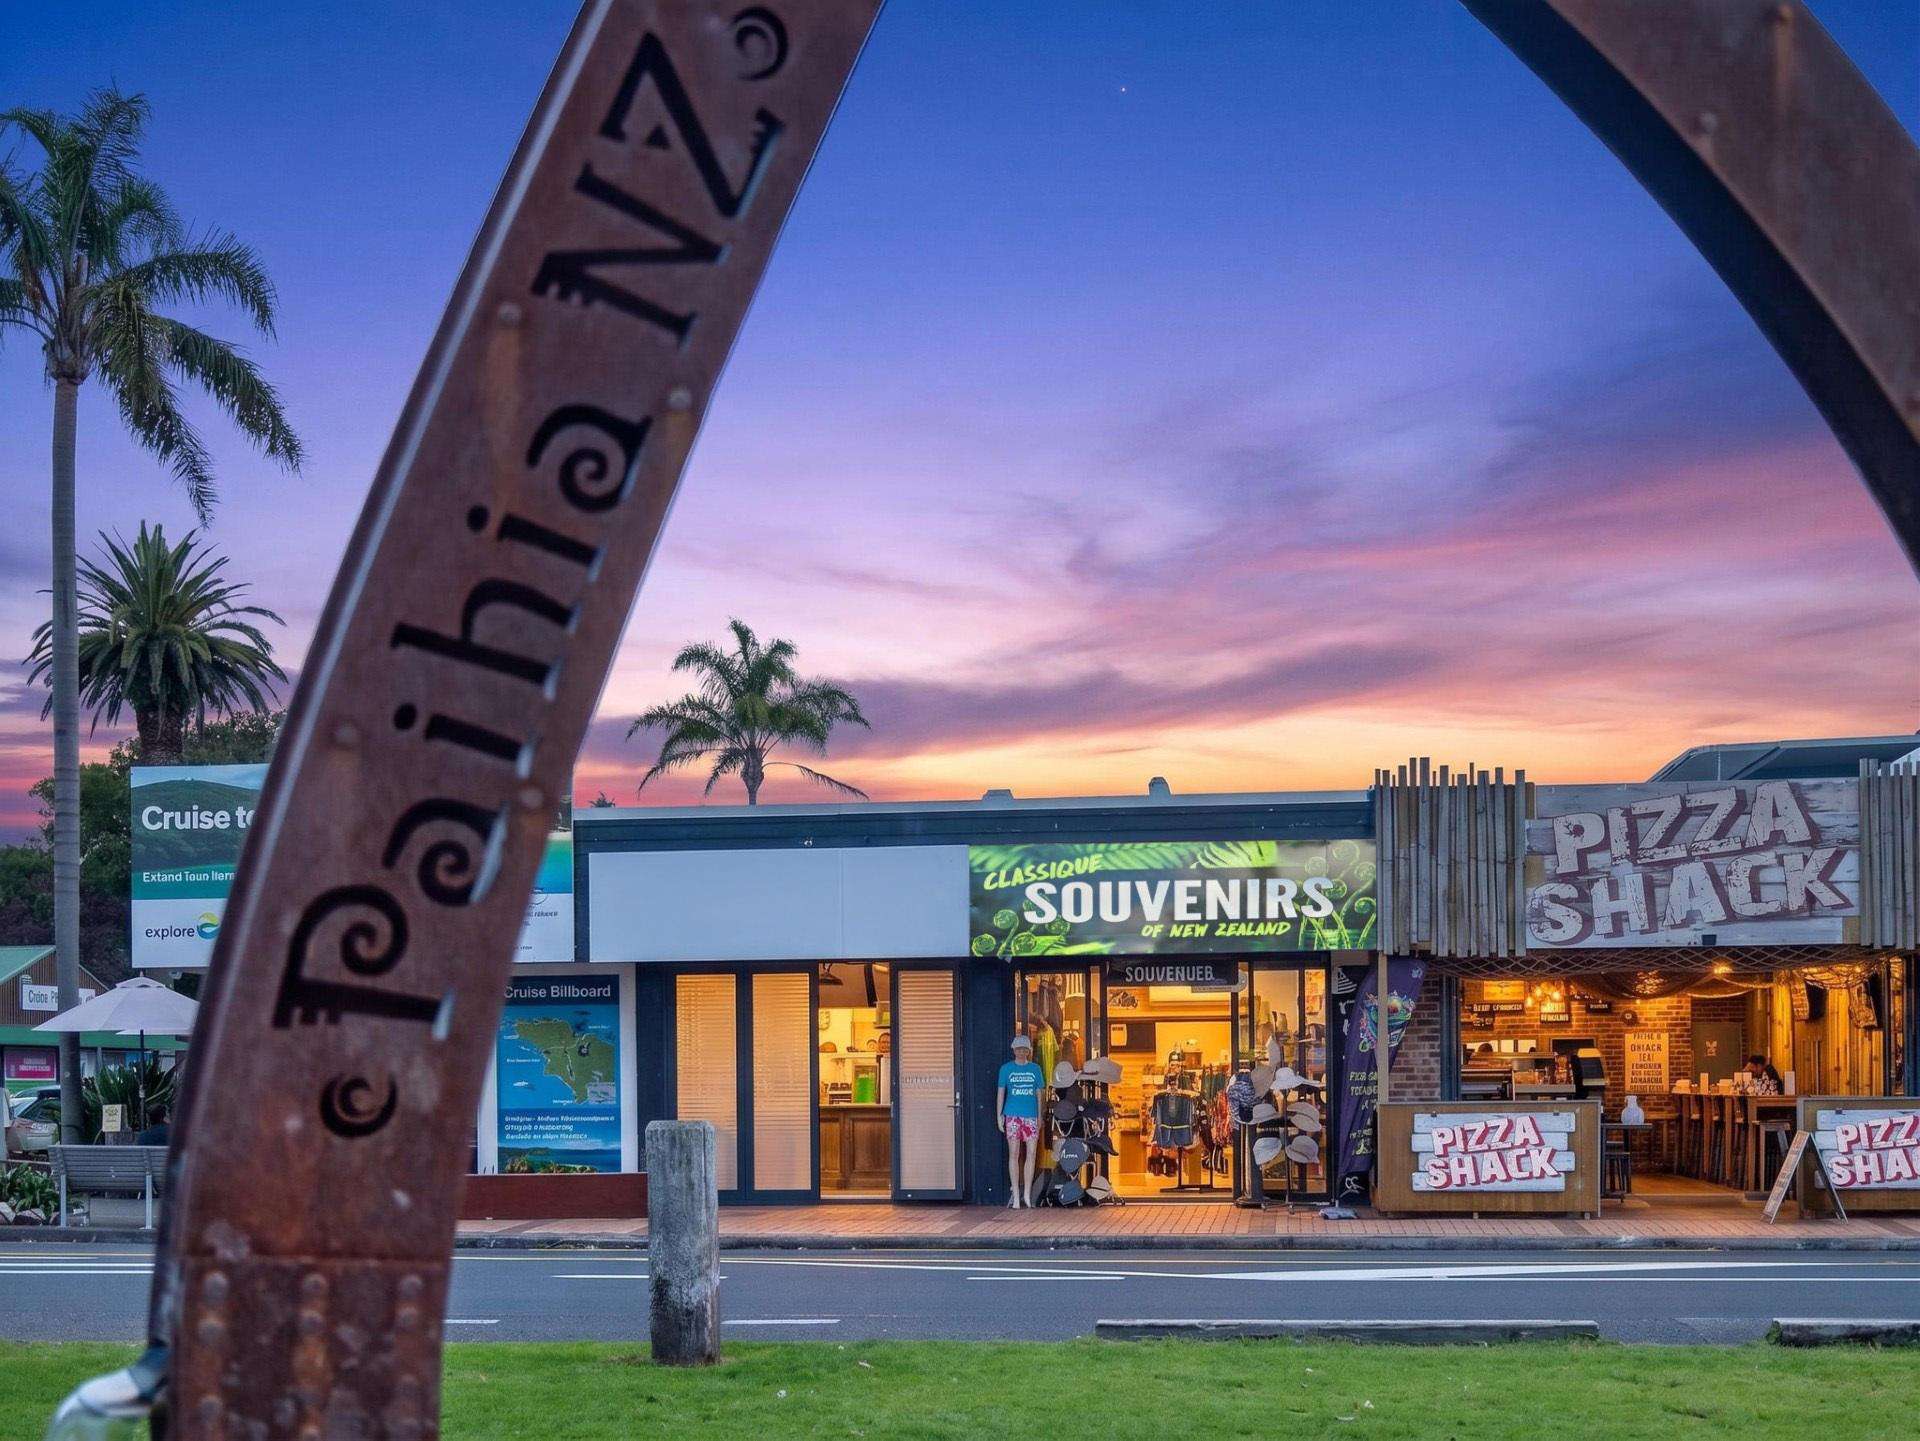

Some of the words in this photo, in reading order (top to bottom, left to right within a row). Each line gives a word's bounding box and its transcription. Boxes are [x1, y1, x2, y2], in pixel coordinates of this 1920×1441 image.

[272, 402, 654, 1041] Paihia
[531, 31, 786, 352] NZ
[141, 804, 231, 831] Cruise
[1552, 780, 1817, 875] PIZZA
[983, 853, 1104, 891] CLASSIQUE
[1023, 876, 1334, 925] SOUVENIRS
[1527, 846, 1851, 944] SHACK
[145, 925, 196, 940] explore
[1140, 923, 1163, 938] OF
[1169, 922, 1209, 938] NEW
[1214, 921, 1292, 937] ZEALAND
[503, 986, 547, 999] Cruise
[550, 984, 611, 998] Billboard
[1431, 1115, 1542, 1157] PIZZA
[1835, 1114, 1920, 1154] PIZZ
[1424, 1146, 1561, 1188] SHACK
